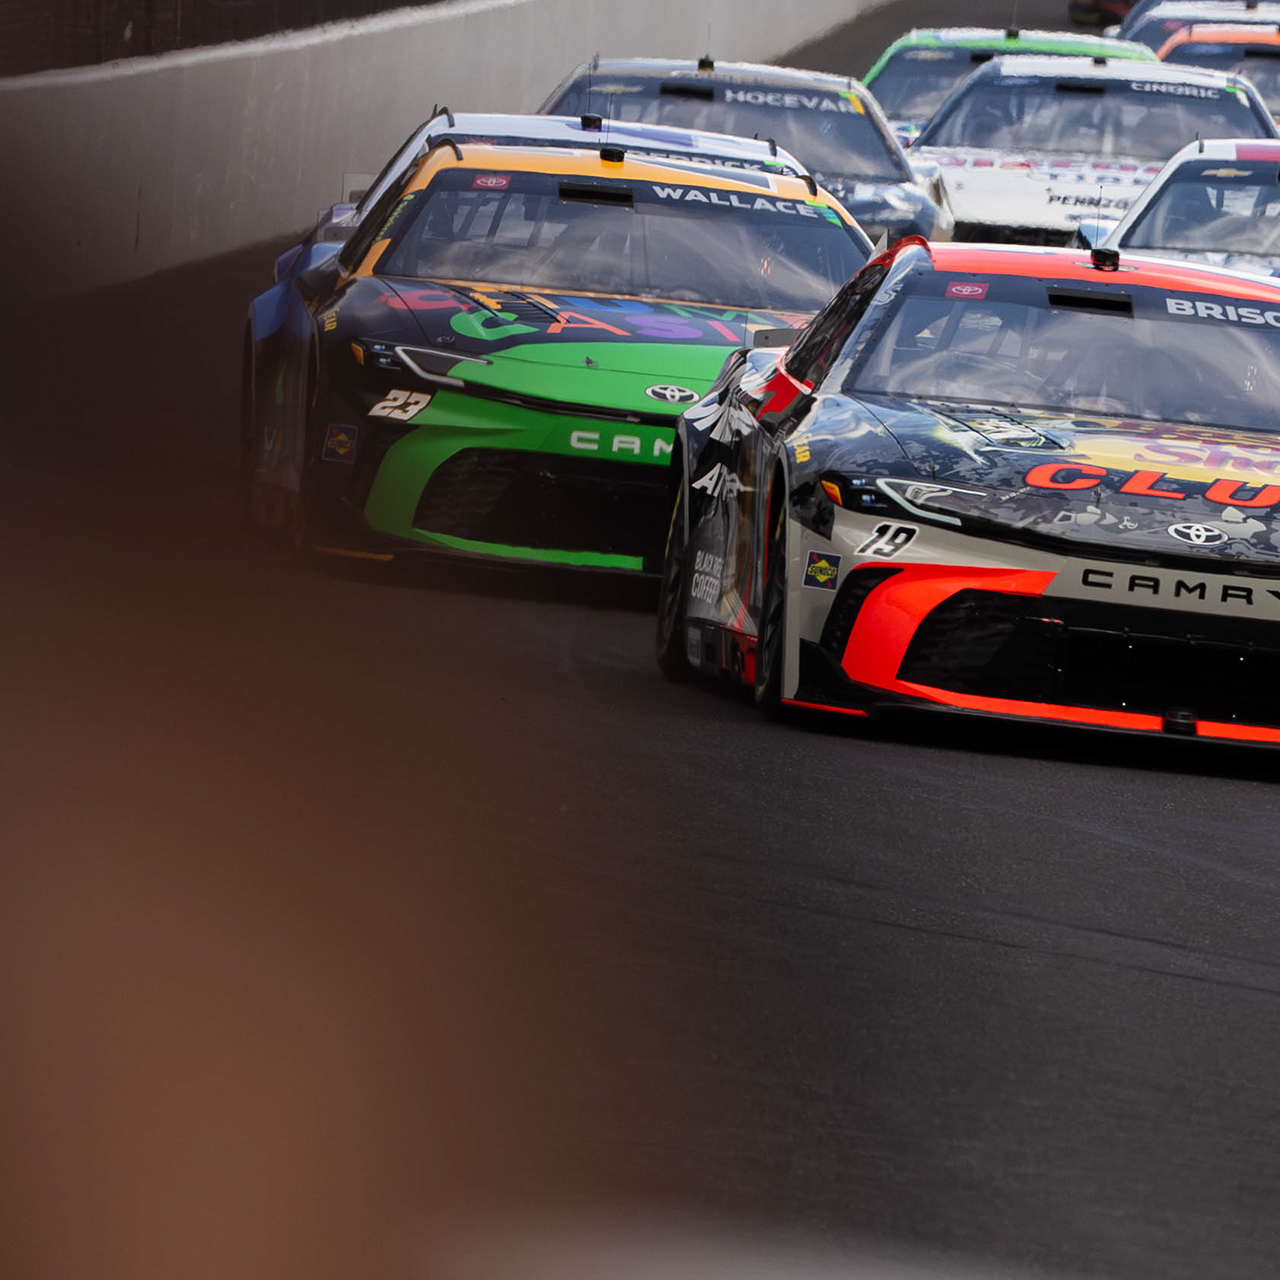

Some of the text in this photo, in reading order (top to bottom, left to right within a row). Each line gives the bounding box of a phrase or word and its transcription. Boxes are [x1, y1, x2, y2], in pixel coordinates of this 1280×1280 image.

[652, 185, 819, 218] WALLACE
[367, 388, 432, 421] 23
[853, 521, 919, 559] 19
